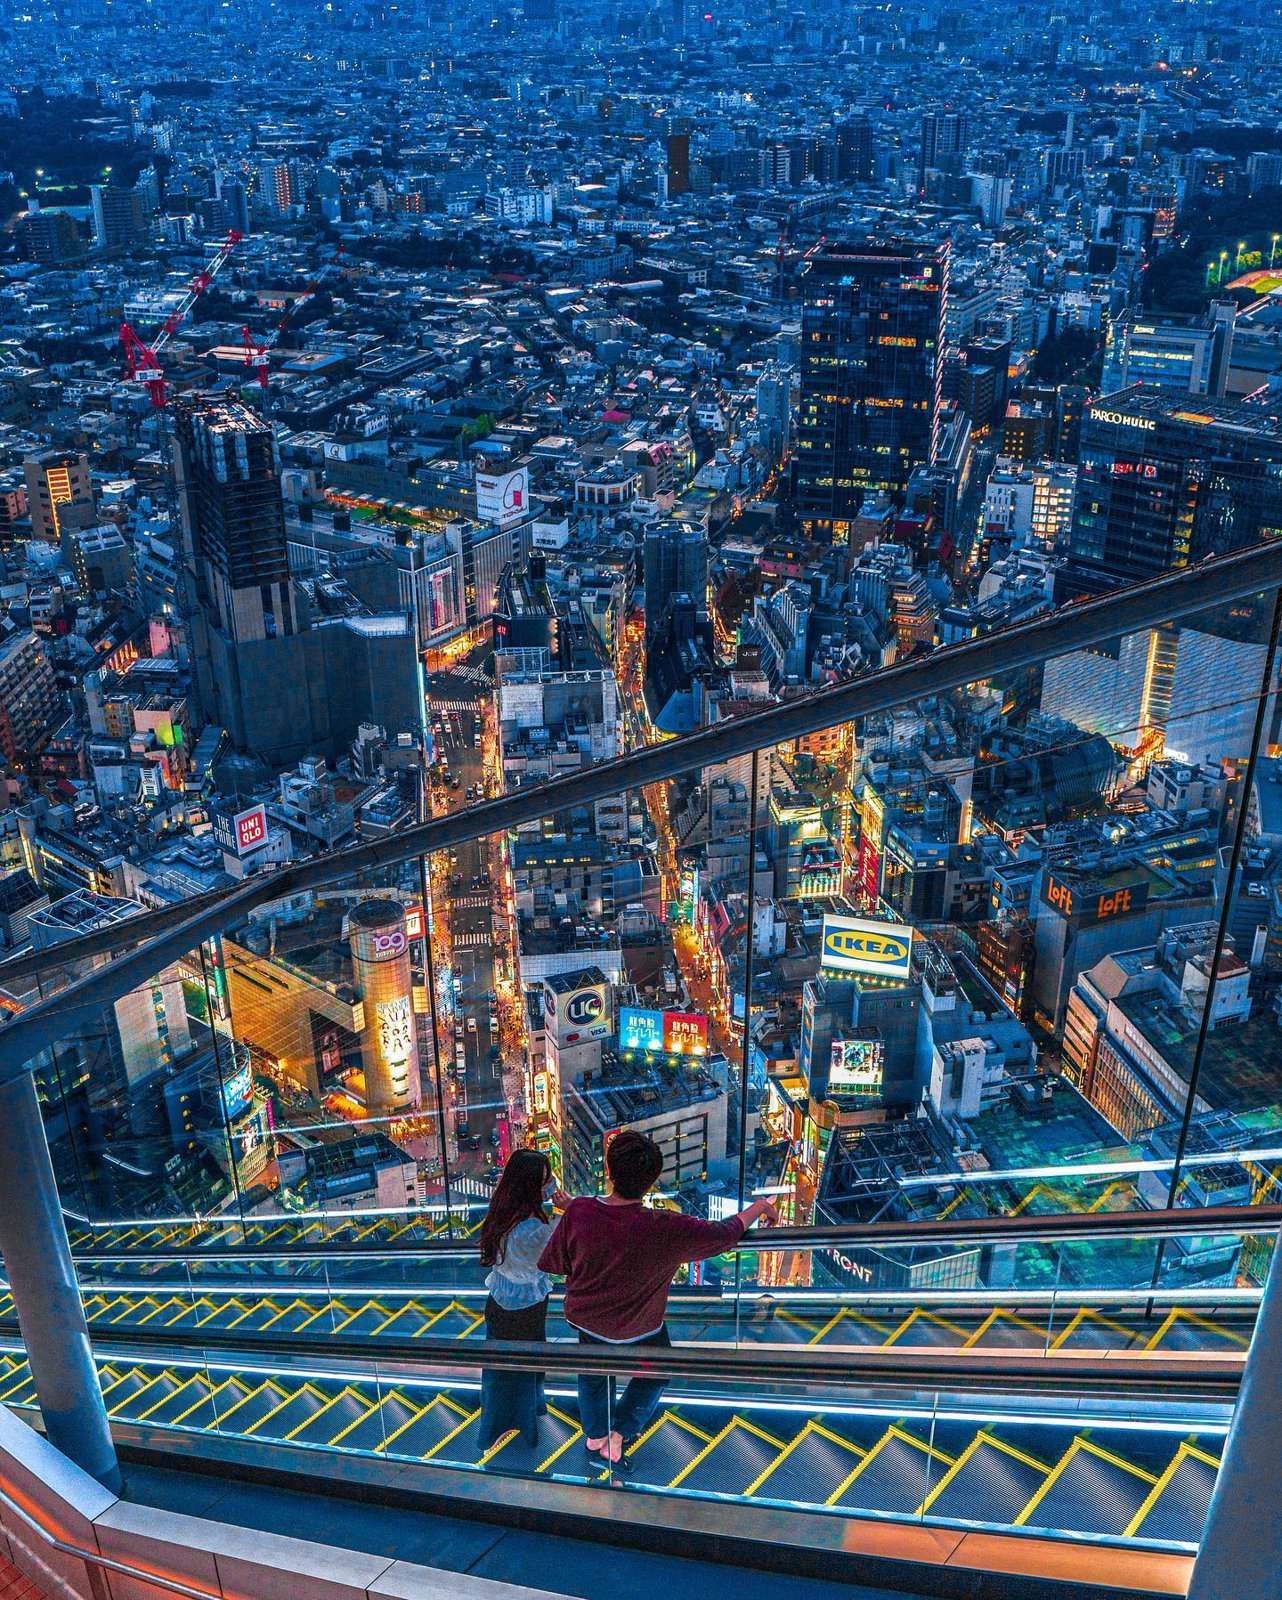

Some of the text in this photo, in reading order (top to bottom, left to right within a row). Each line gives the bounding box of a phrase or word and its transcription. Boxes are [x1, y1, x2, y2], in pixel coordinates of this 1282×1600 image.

[1090, 408, 1156, 430] PARCO HULIC
[216, 814, 230, 832] THE
[241, 816, 259, 832] UNI
[213, 826, 237, 850] PRIME
[242, 827, 261, 844] QLO
[372, 932, 405, 953] 109
[833, 935, 902, 957] IKEA
[590, 1027, 607, 1036] VISA
